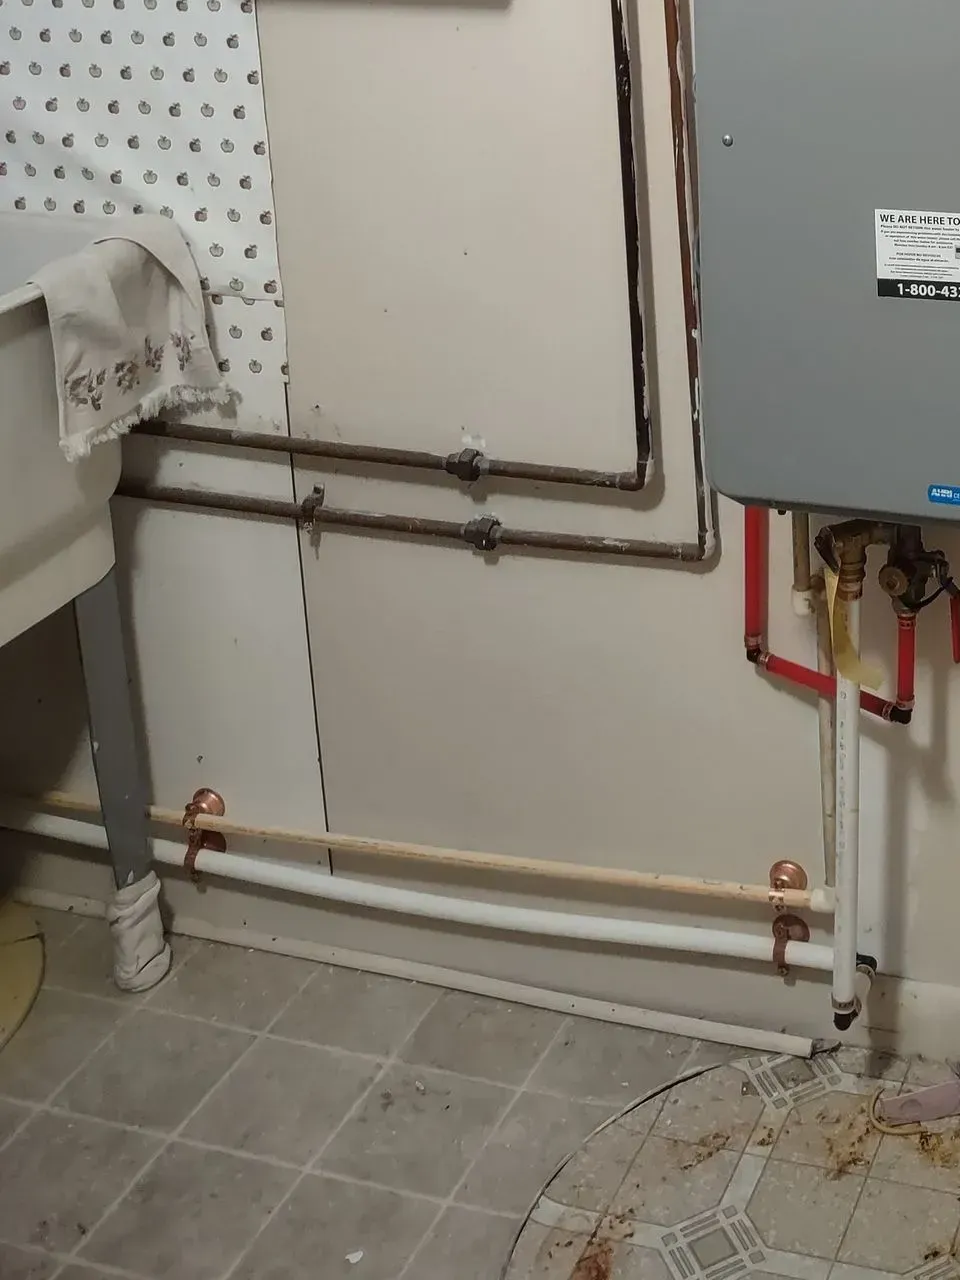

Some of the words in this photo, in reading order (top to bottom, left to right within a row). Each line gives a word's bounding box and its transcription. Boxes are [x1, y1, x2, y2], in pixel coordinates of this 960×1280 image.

[879, 214, 895, 223] WE
[897, 215, 917, 224] ARE
[920, 216, 945, 225] HERE
[947, 217, 960, 226] TO
[931, 488, 952, 498] AHRI
